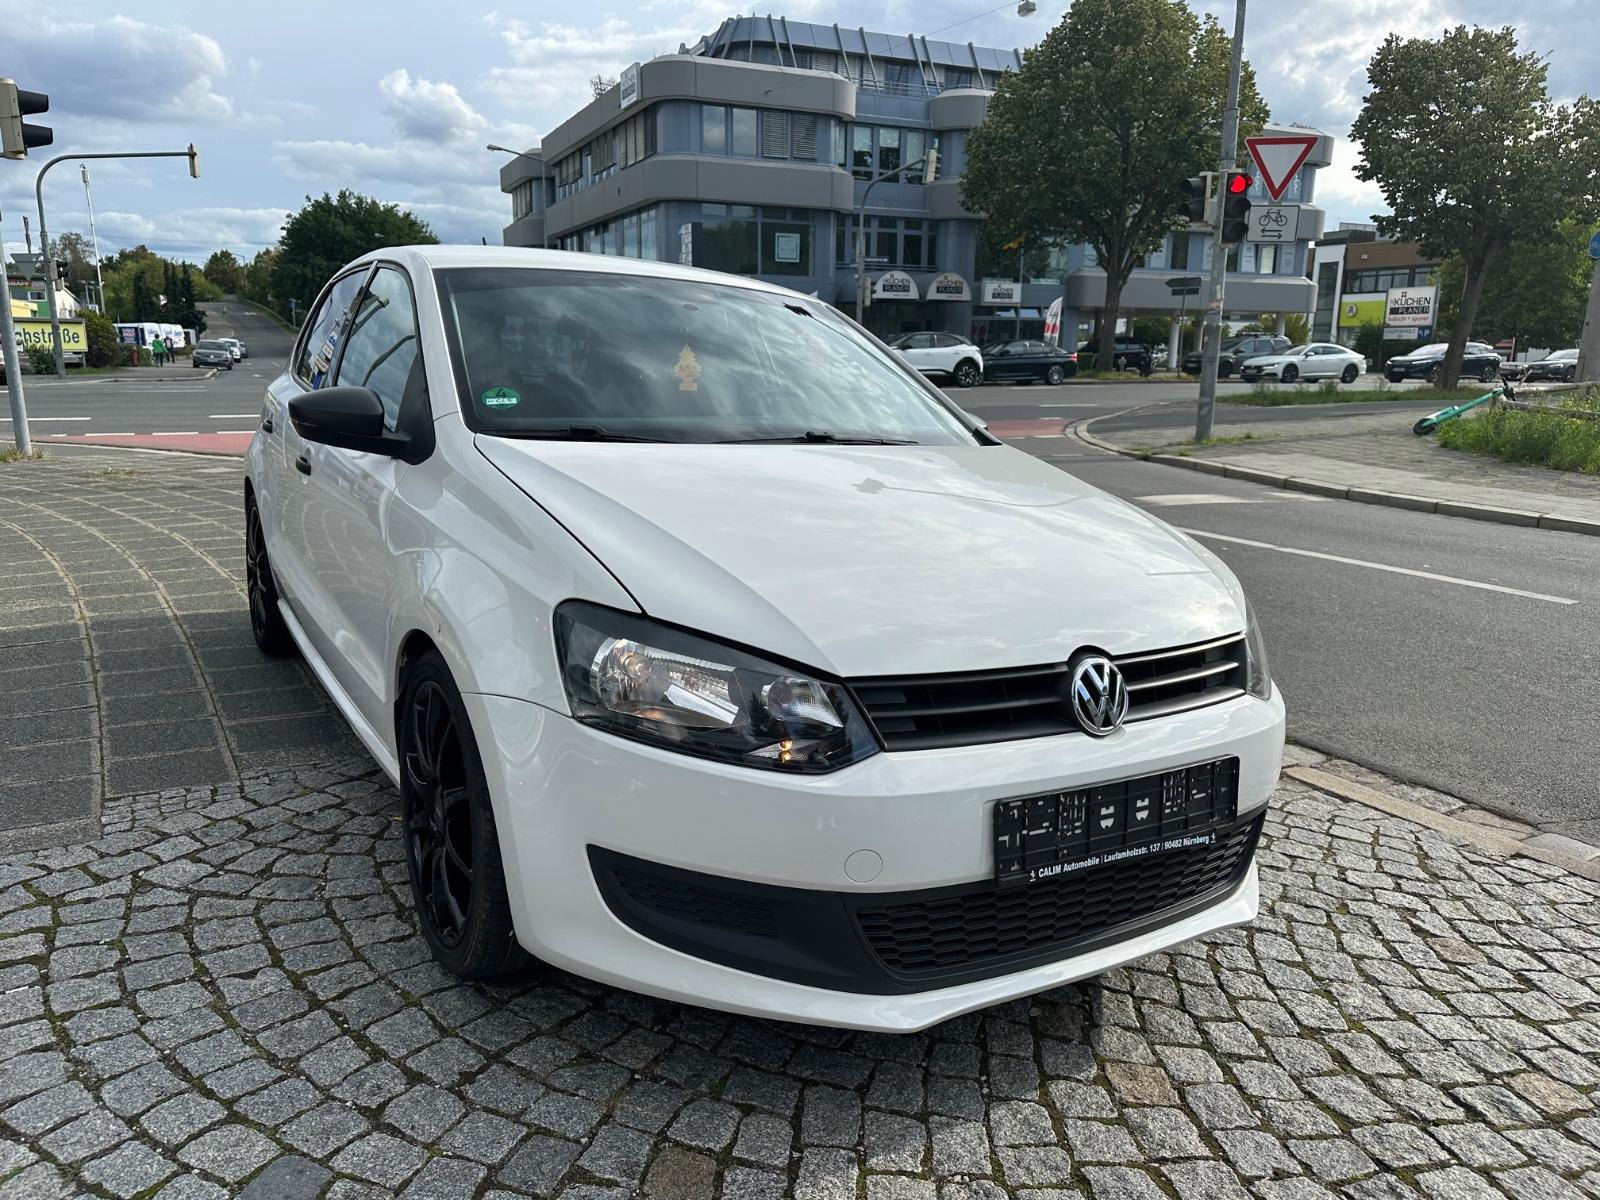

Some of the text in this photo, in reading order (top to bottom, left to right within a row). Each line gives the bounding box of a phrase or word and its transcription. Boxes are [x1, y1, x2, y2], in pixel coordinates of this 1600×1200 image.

[1393, 292, 1431, 306] KÜCHEN
[1399, 306, 1429, 314] PLANER
[496, 388, 507, 398] 4
[1038, 864, 1062, 878] CALIM
[1063, 857, 1100, 872] Automobile
[1149, 842, 1161, 853] 137
[1164, 839, 1182, 850] 90482
[1183, 836, 1209, 846] Nürnberg
